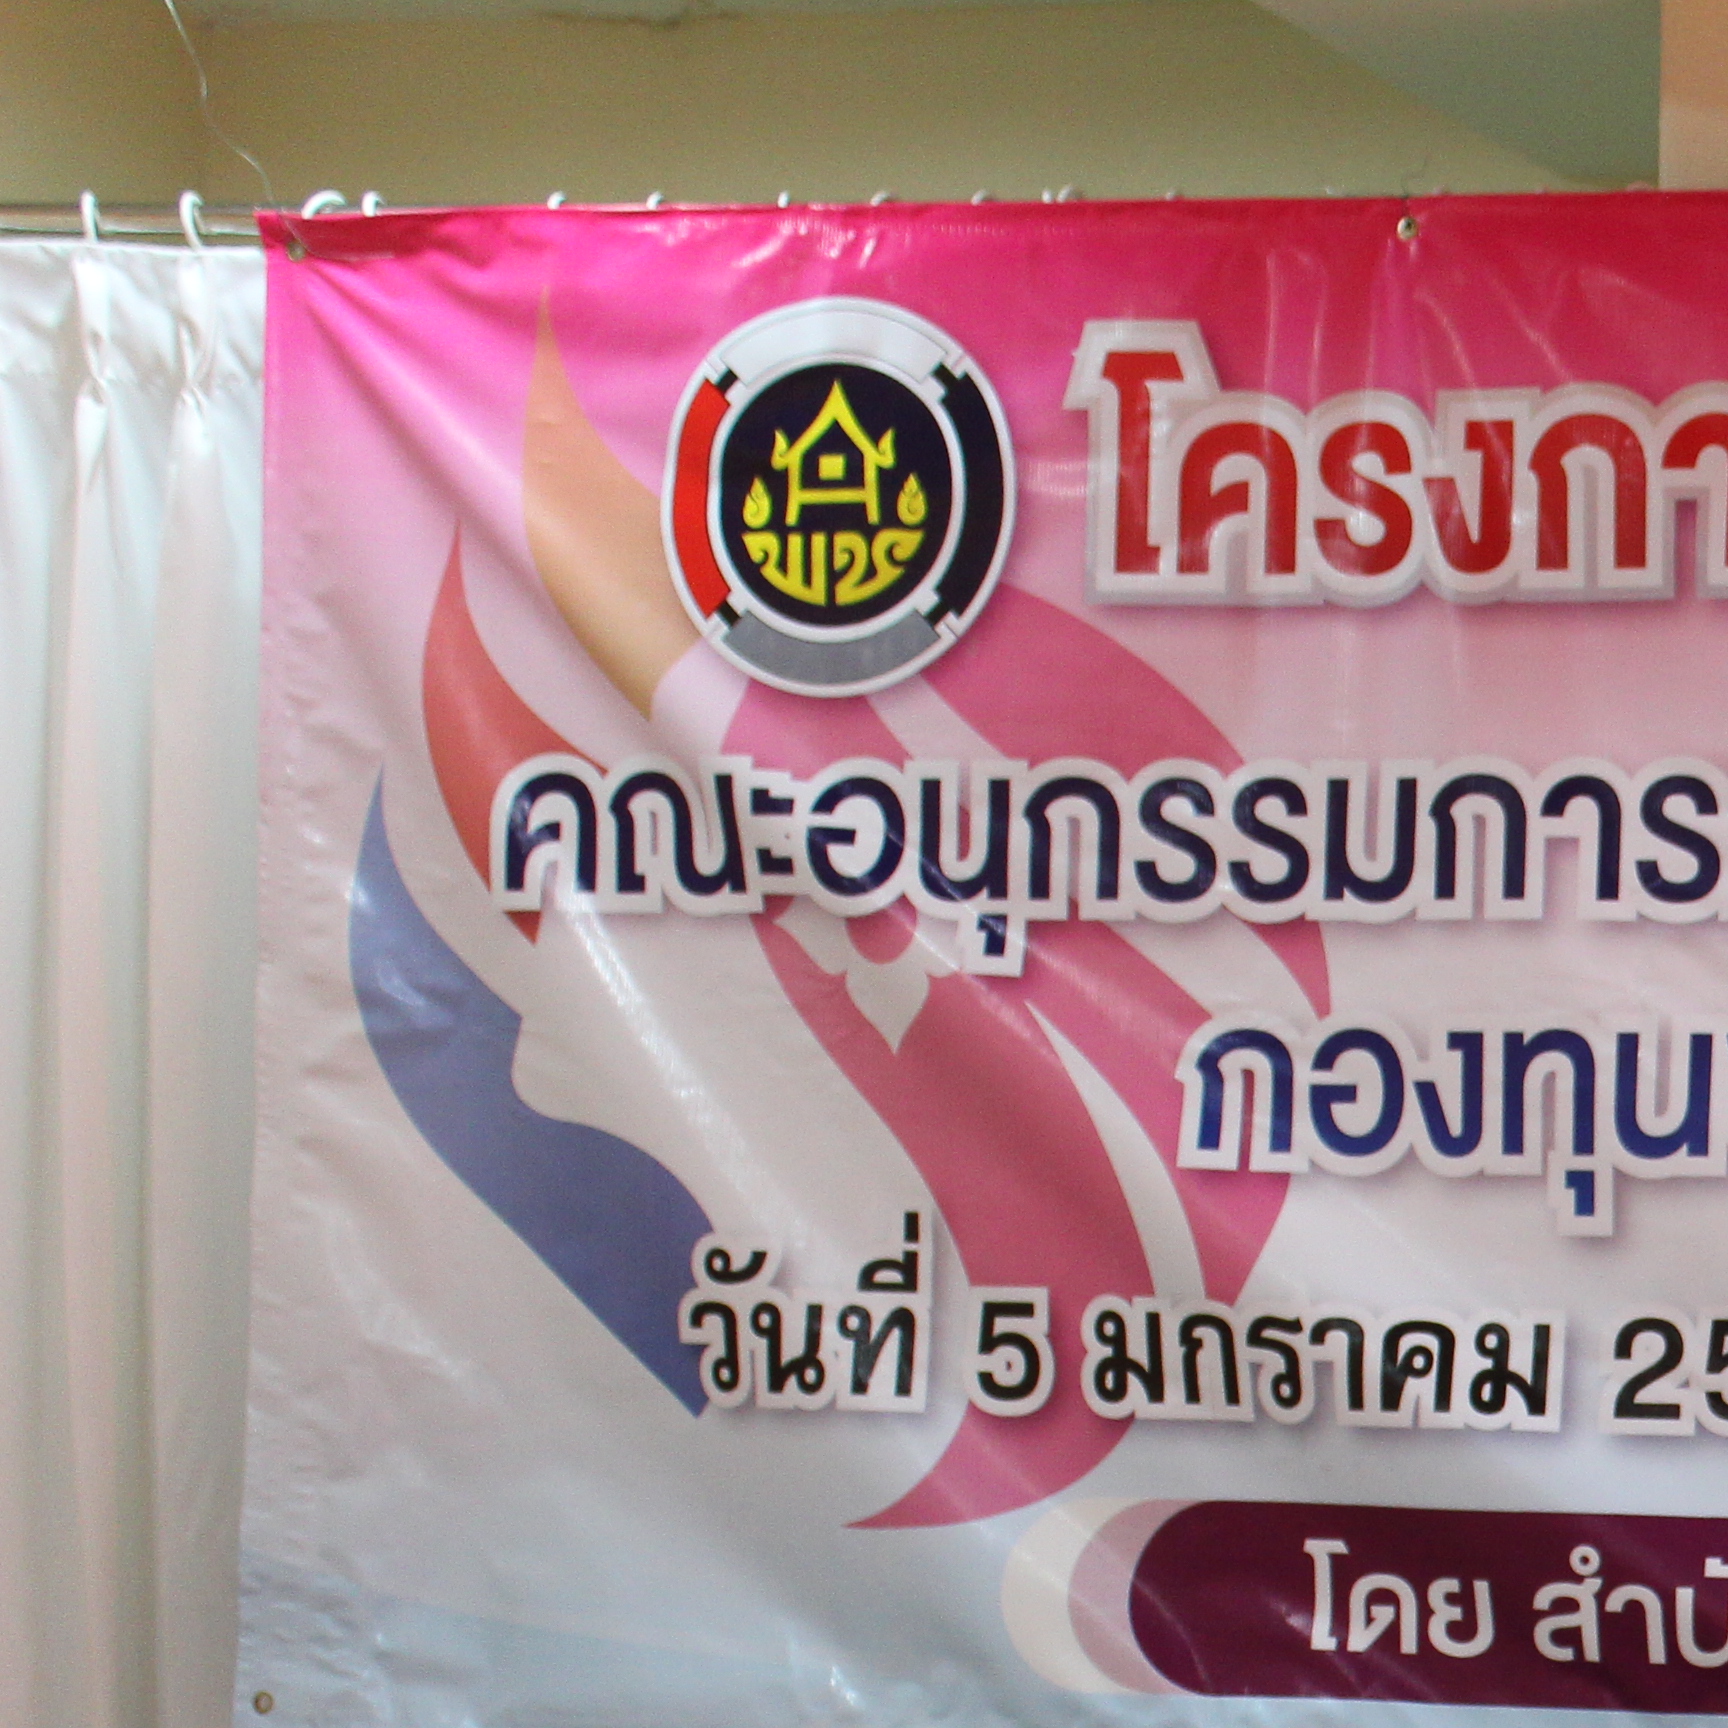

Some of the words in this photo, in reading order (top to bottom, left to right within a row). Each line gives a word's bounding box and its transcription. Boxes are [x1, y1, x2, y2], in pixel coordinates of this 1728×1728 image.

[688, 1212, 921, 1398] วันที่
[978, 1300, 1042, 1401] 5
[1092, 1302, 1553, 1416] มกราคม
[1302, 1538, 1496, 1658] โดย
